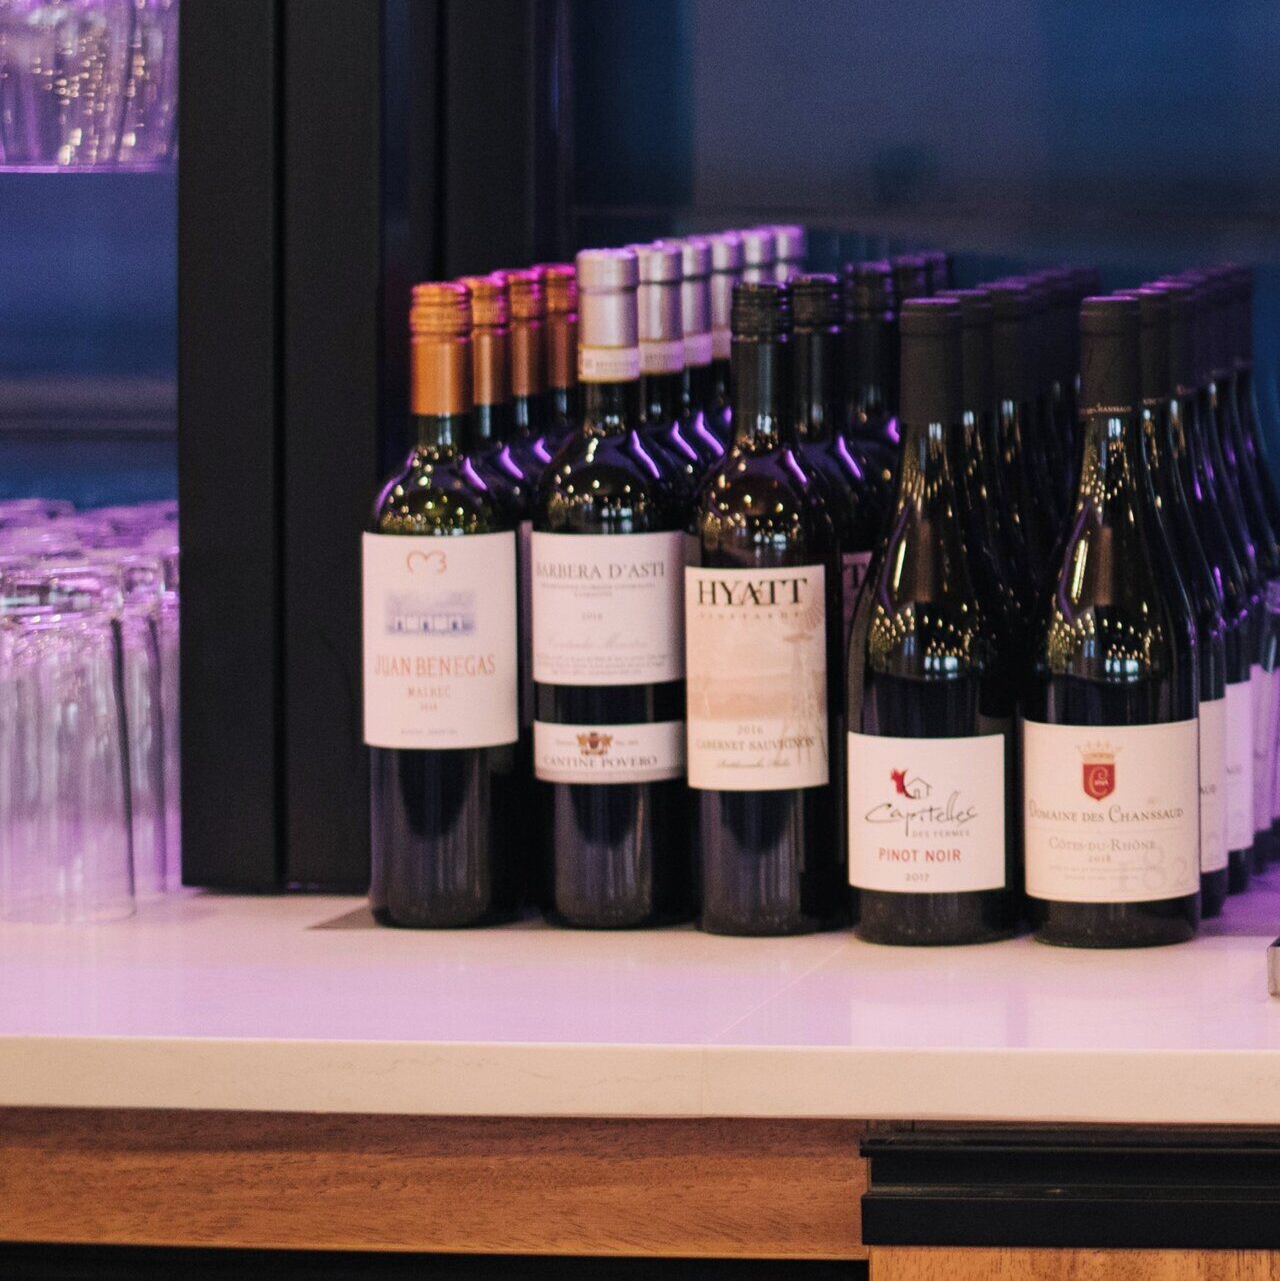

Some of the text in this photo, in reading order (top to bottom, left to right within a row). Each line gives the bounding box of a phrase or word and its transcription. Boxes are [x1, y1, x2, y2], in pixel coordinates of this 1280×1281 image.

[608, 561, 666, 579] D'ASTI
[696, 577, 808, 607] HYATT
[374, 653, 497, 678] JUAN BENEGAS
[601, 755, 659, 769] POVERO
[1028, 798, 1185, 824] DOMAINE DES CHANSSAUD
[879, 846, 962, 864] PINOT NOIR
[905, 872, 931, 883] 2017
